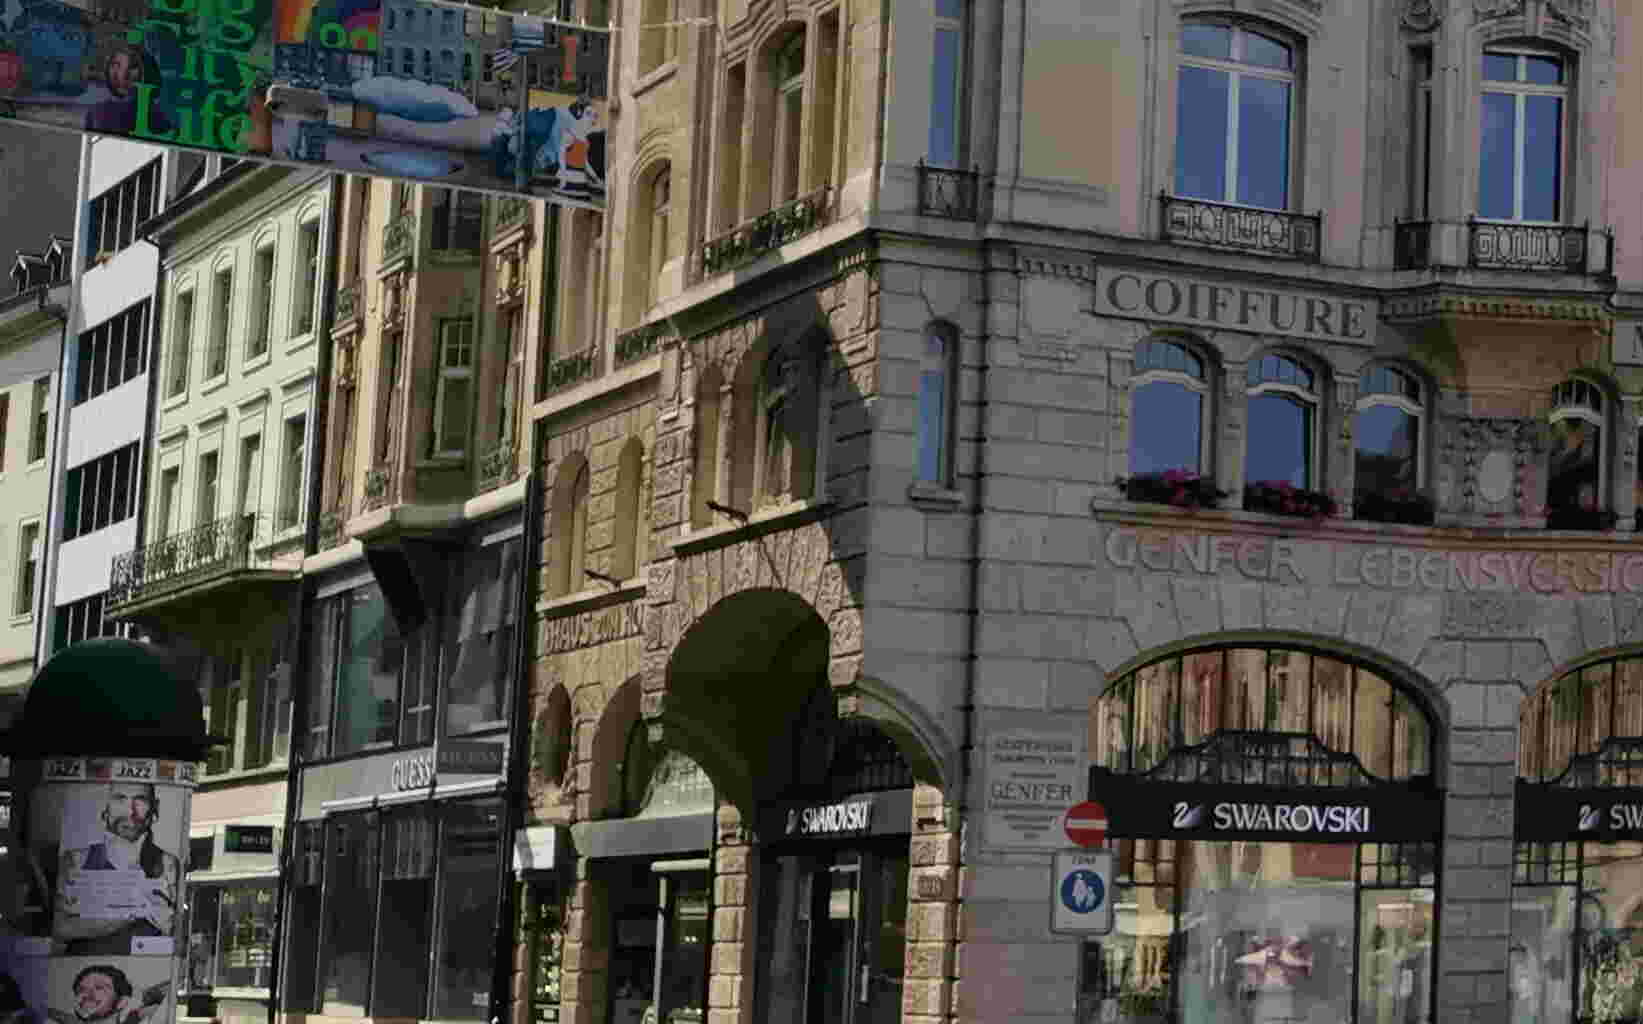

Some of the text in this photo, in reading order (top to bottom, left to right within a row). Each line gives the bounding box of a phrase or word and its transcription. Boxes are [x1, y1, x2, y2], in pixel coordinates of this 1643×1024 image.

[132, 82, 254, 153] Life
[1105, 273, 1367, 339] COIFFURE
[1104, 526, 1304, 586] GENFER
[391, 756, 434, 790] GUESS
[800, 799, 872, 834] SWAROVSKI
[1213, 801, 1370, 833] SWAROVSKI
